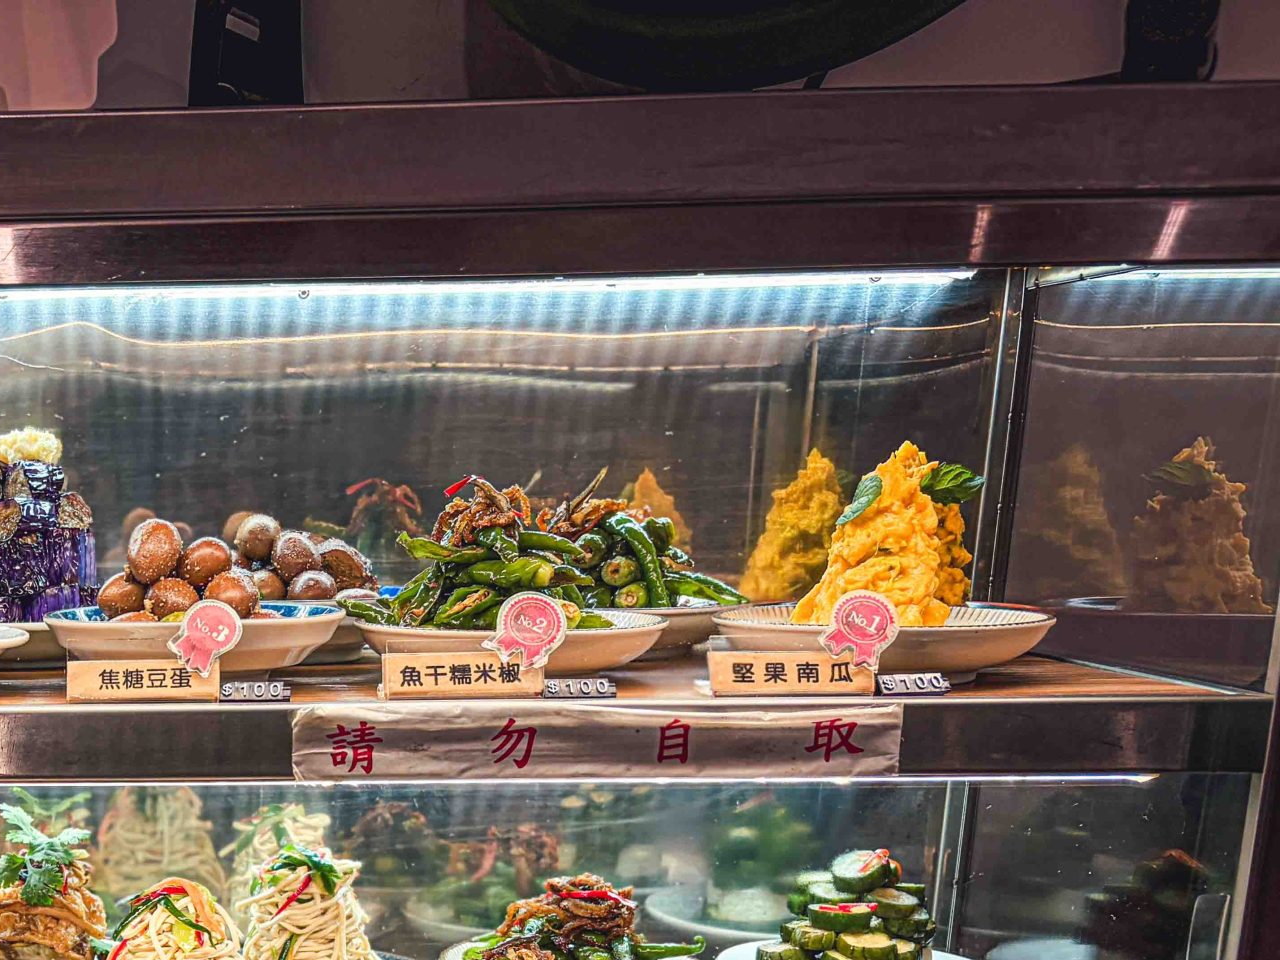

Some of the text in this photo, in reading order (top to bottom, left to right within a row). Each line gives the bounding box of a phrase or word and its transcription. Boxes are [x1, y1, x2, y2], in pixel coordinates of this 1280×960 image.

[98, 668, 192, 690] 焦糖豆蛋
[400, 662, 522, 687] 魚干糯米椒
[732, 661, 853, 684] 堅果南瓜
[221, 682, 282, 698] $100
[547, 680, 609, 695] $100
[881, 675, 943, 691] $100
